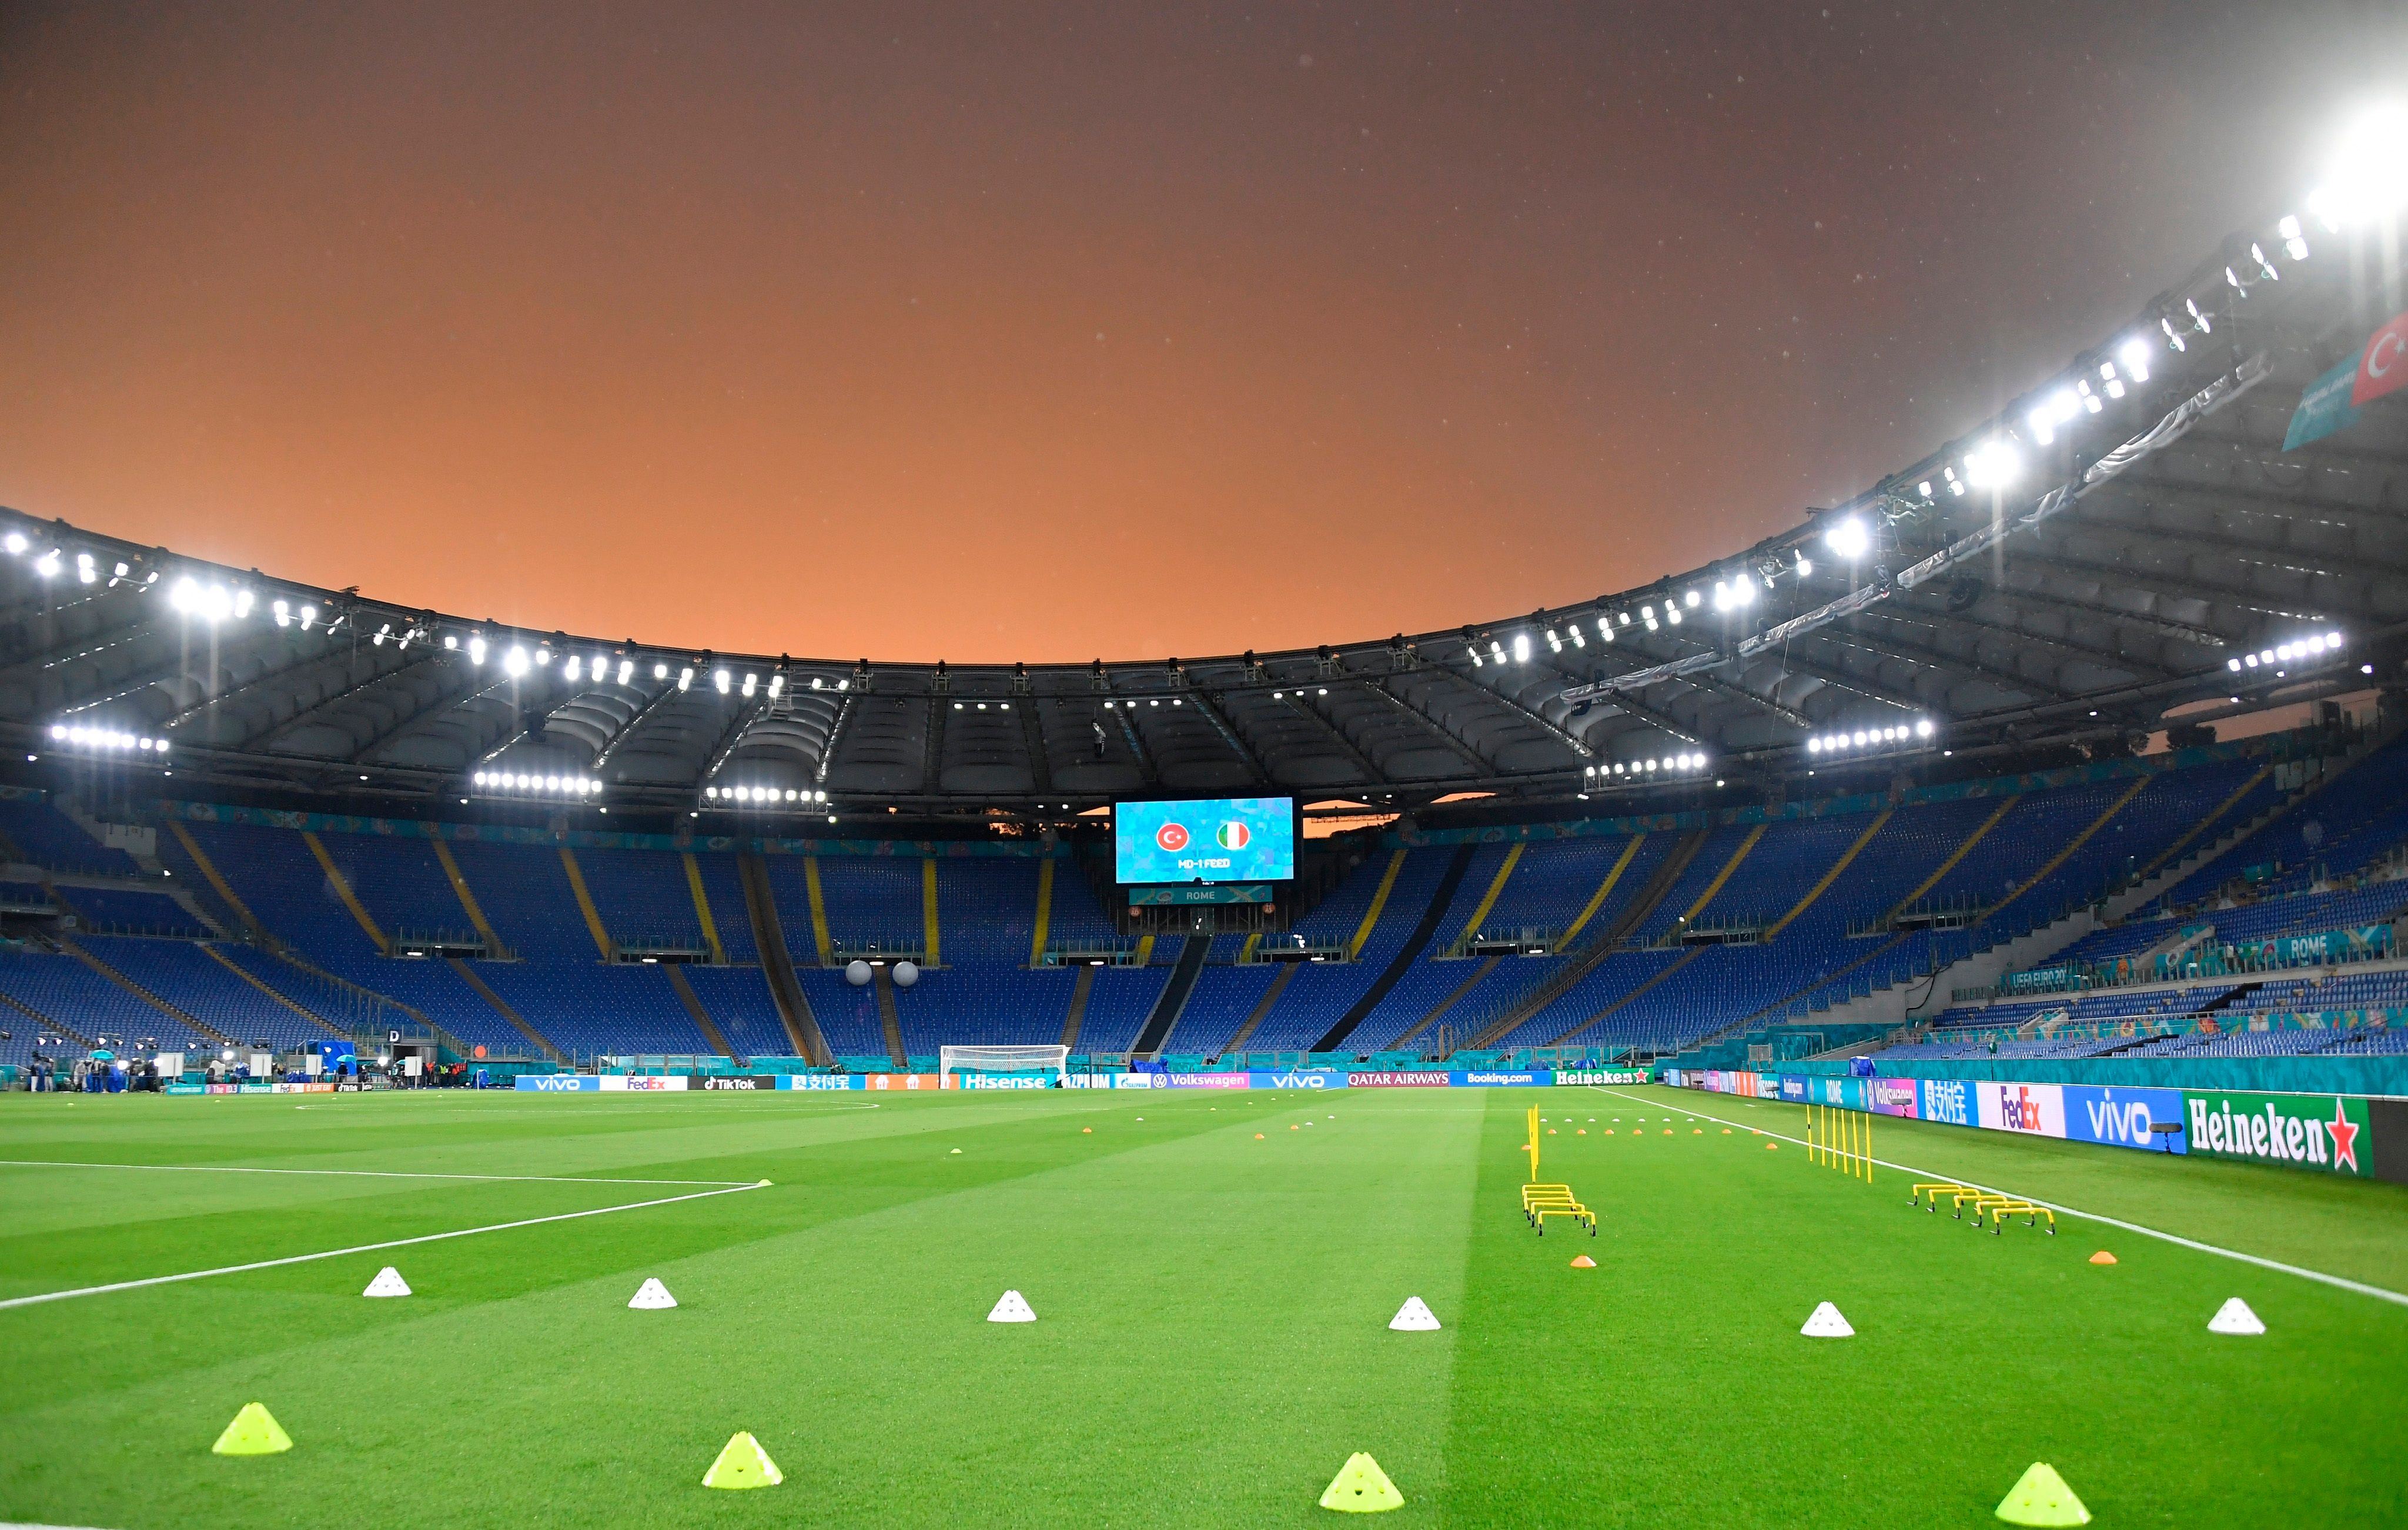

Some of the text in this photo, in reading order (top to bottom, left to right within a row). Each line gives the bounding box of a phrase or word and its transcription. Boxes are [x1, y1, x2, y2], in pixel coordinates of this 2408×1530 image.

[1178, 858, 1230, 869] MD-1 FEED
[1186, 891, 1215, 900] ROME
[2291, 935, 2327, 959] ROME
[2013, 973, 2032, 987] UEFA
[2034, 970, 2054, 986] EURO
[390, 1030, 399, 1042] D
[535, 1076, 580, 1090] vivo
[627, 1077, 665, 1090] FedEx
[808, 1074, 850, 1090] 支付宝
[965, 1074, 1046, 1089] Hisense
[1171, 1074, 1245, 1086] Volkswagen
[1272, 1073, 1325, 1088] vivo
[1348, 1073, 1449, 1086] QATAR AIRWAYS
[1467, 1073, 1533, 1084] Booking.com
[1556, 1070, 1633, 1084] Heineken
[241, 1084, 271, 1093] Hisense
[717, 1079, 755, 1090] TikTok
[1826, 1080, 1842, 1103] ROME
[1936, 1080, 1967, 1123] 支付宝
[2000, 1086, 2041, 1130] FedEx
[2086, 1087, 2152, 1144] vivo
[2189, 1099, 2328, 1164] Heineken
